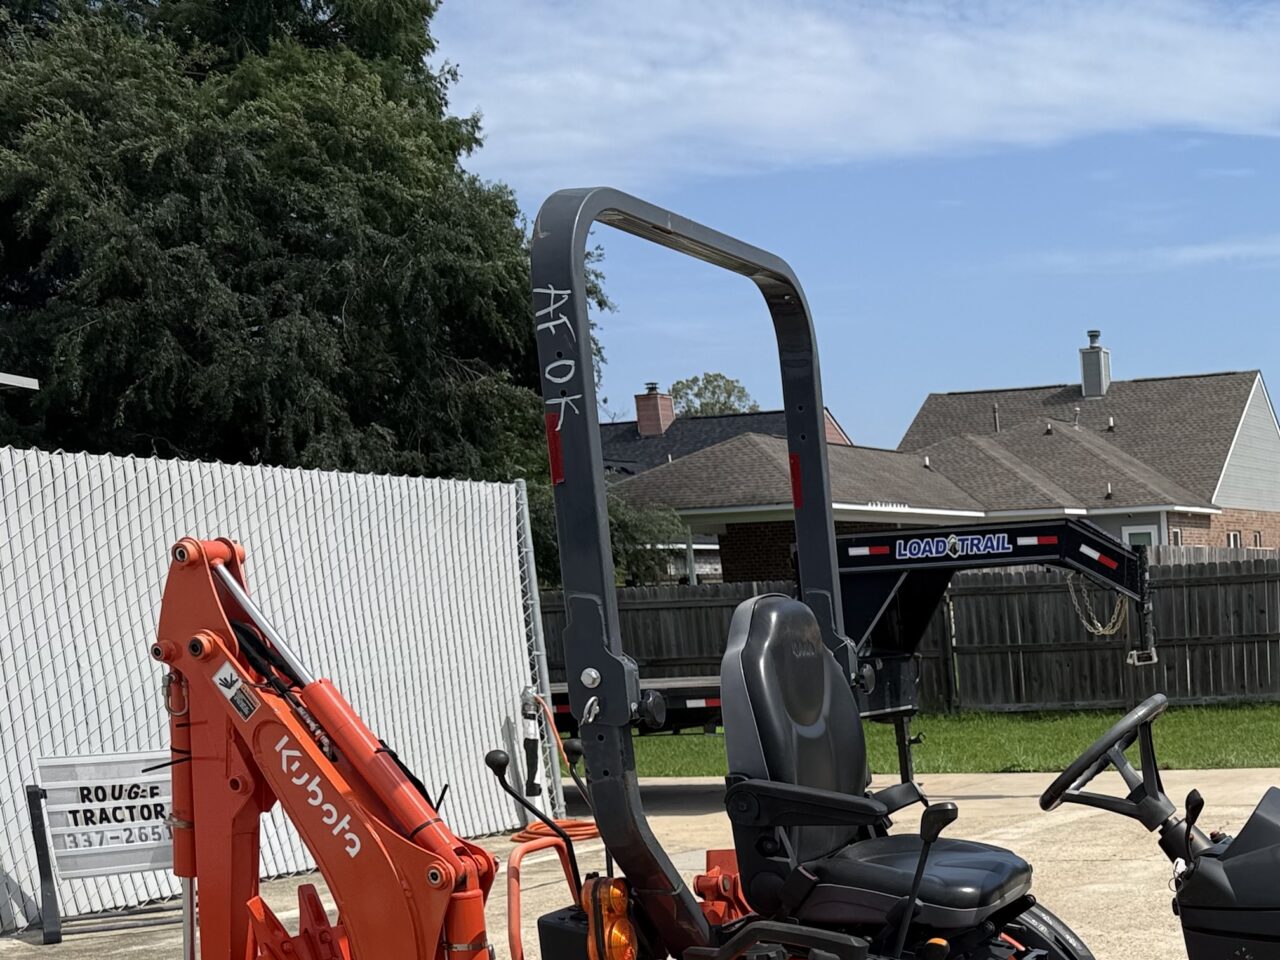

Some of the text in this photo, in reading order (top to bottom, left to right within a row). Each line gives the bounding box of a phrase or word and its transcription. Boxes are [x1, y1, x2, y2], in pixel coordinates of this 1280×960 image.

[896, 533, 1013, 560] LOAD TRAIL
[274, 734, 362, 858] Kubota
[67, 803, 166, 827] TRACTOR
